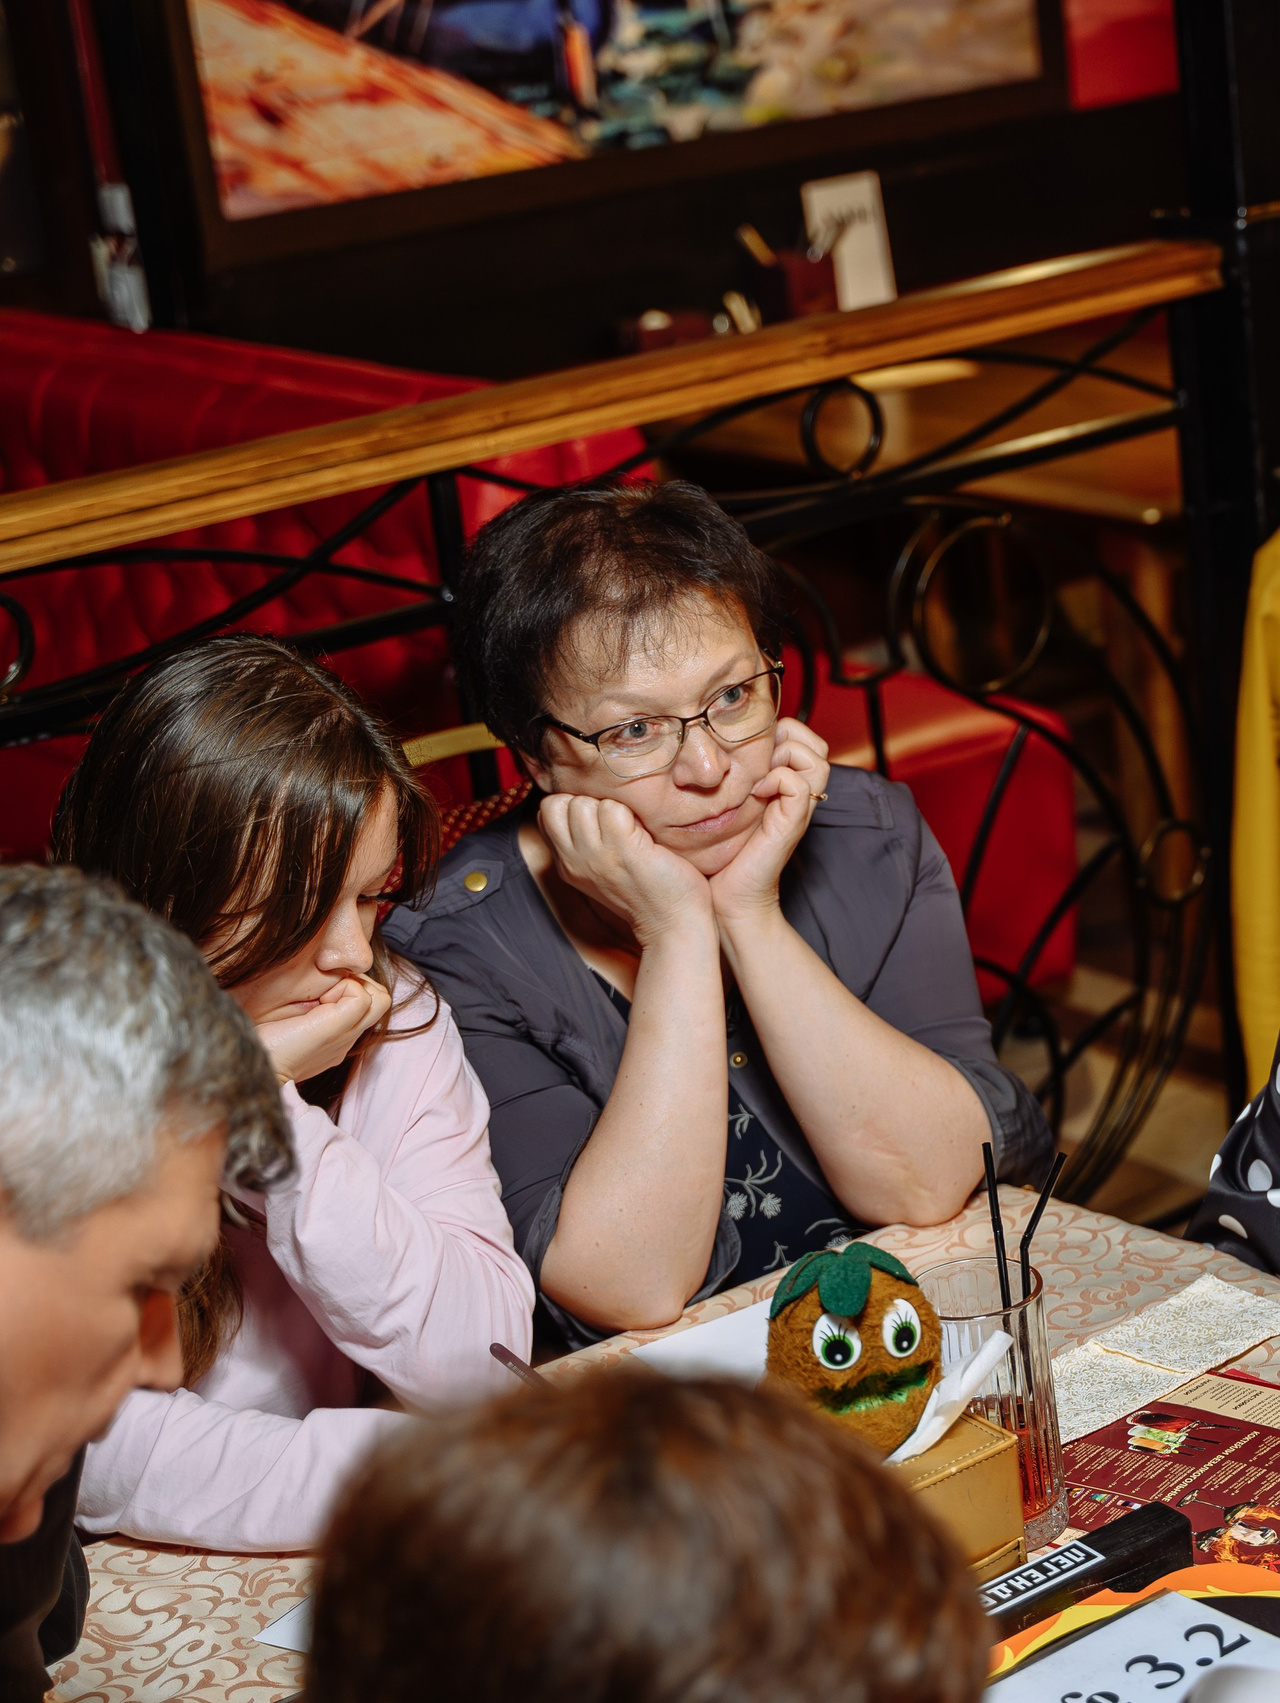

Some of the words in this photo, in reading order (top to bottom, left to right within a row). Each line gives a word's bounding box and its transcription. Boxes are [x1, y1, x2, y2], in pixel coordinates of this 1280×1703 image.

[1220, 1429, 1261, 1456] КОКТЕЙЛИ
[1159, 1453, 1226, 1502] БЕЗАЛКОГОЛЬНЫЕ
[1125, 1623, 1252, 1690] 3.2
